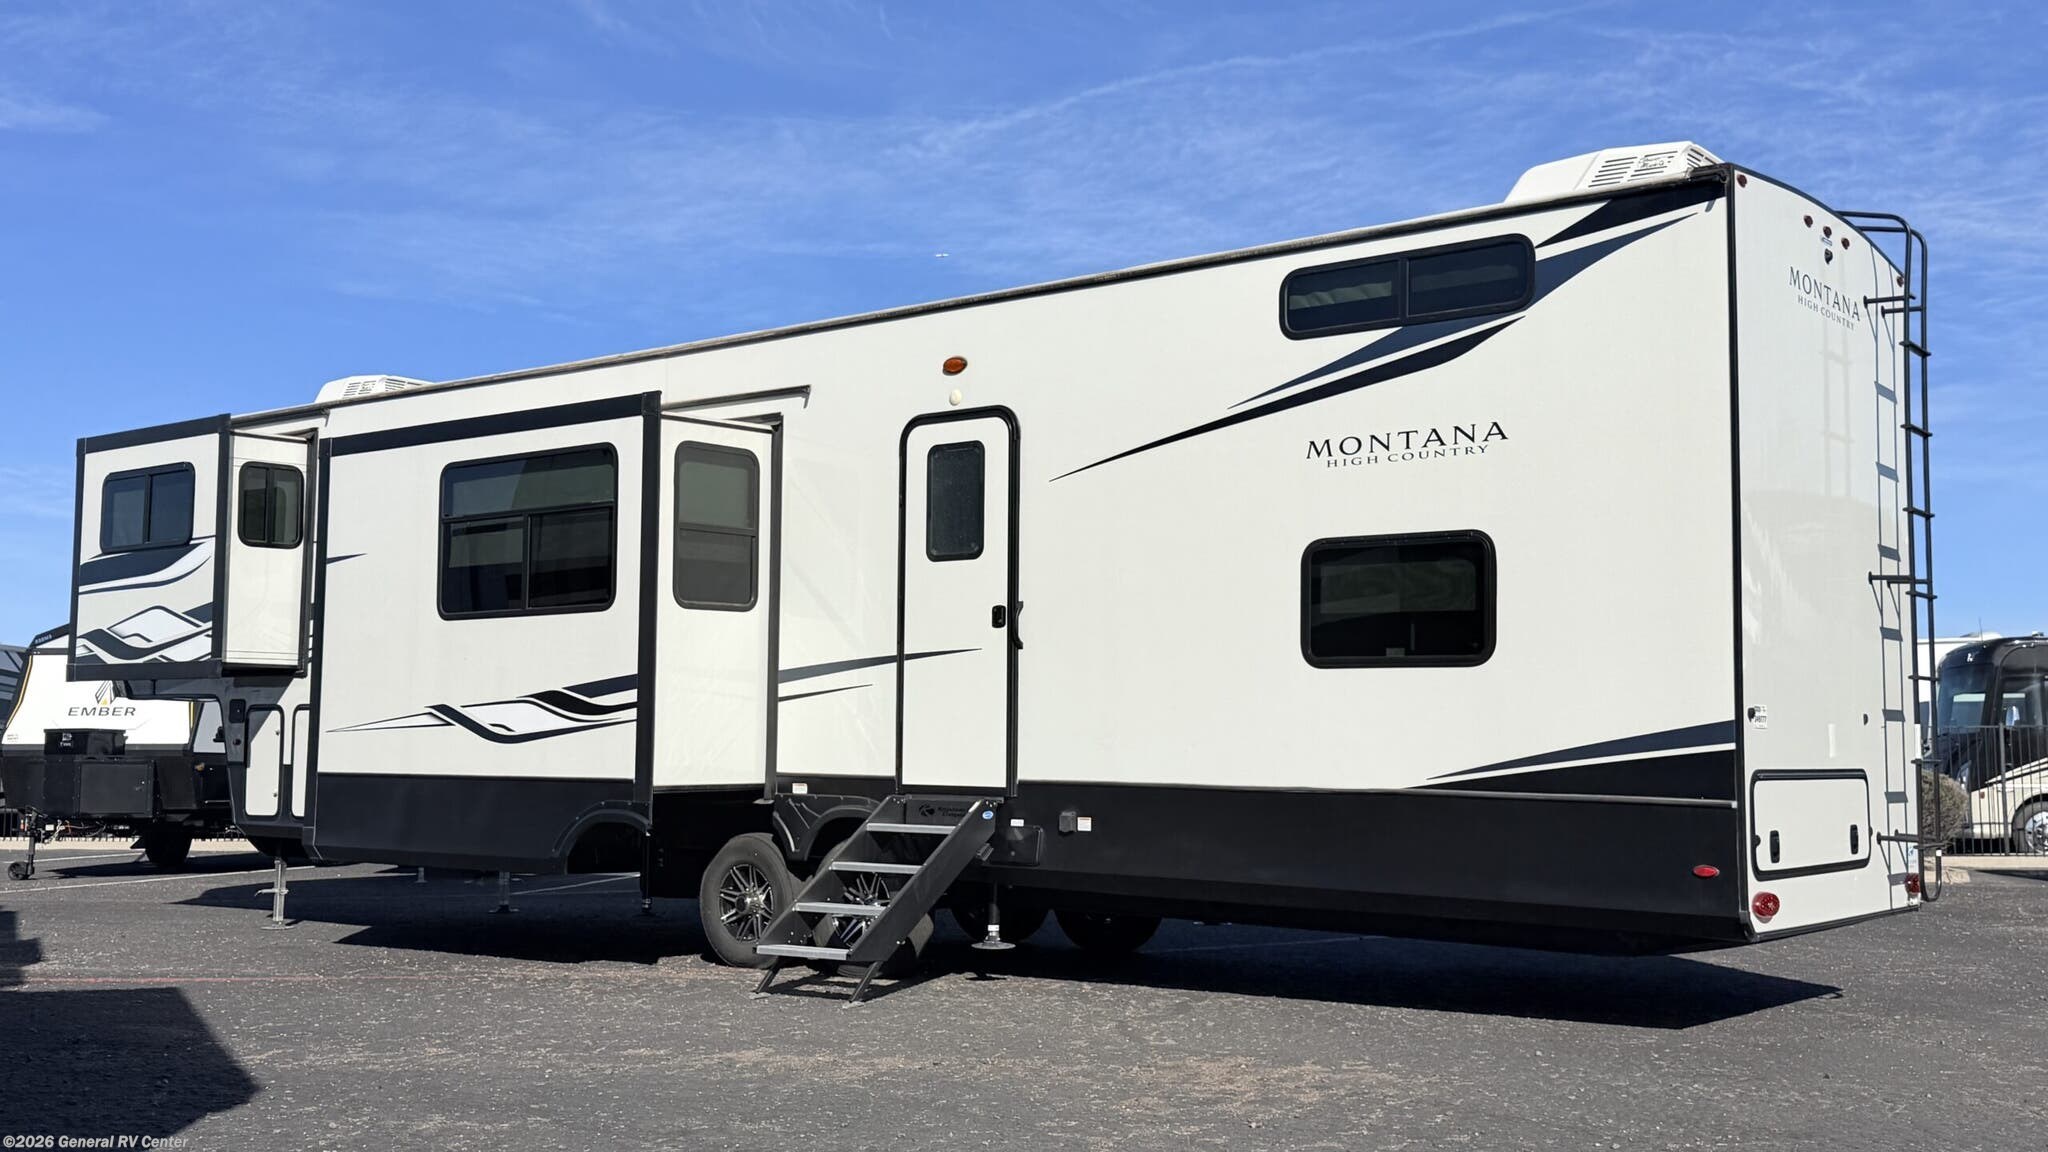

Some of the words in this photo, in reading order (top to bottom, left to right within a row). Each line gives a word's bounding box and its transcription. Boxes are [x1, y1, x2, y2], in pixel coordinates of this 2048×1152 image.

[1789, 266, 1860, 321] MONTANA
[1797, 294, 1819, 313] HIGH
[1820, 306, 1855, 330] COUNTRY
[1306, 421, 1509, 459] MONTANA
[1327, 455, 1379, 468] HIGH
[1387, 444, 1489, 463] COUNTRY
[67, 706, 137, 717] EMBER
